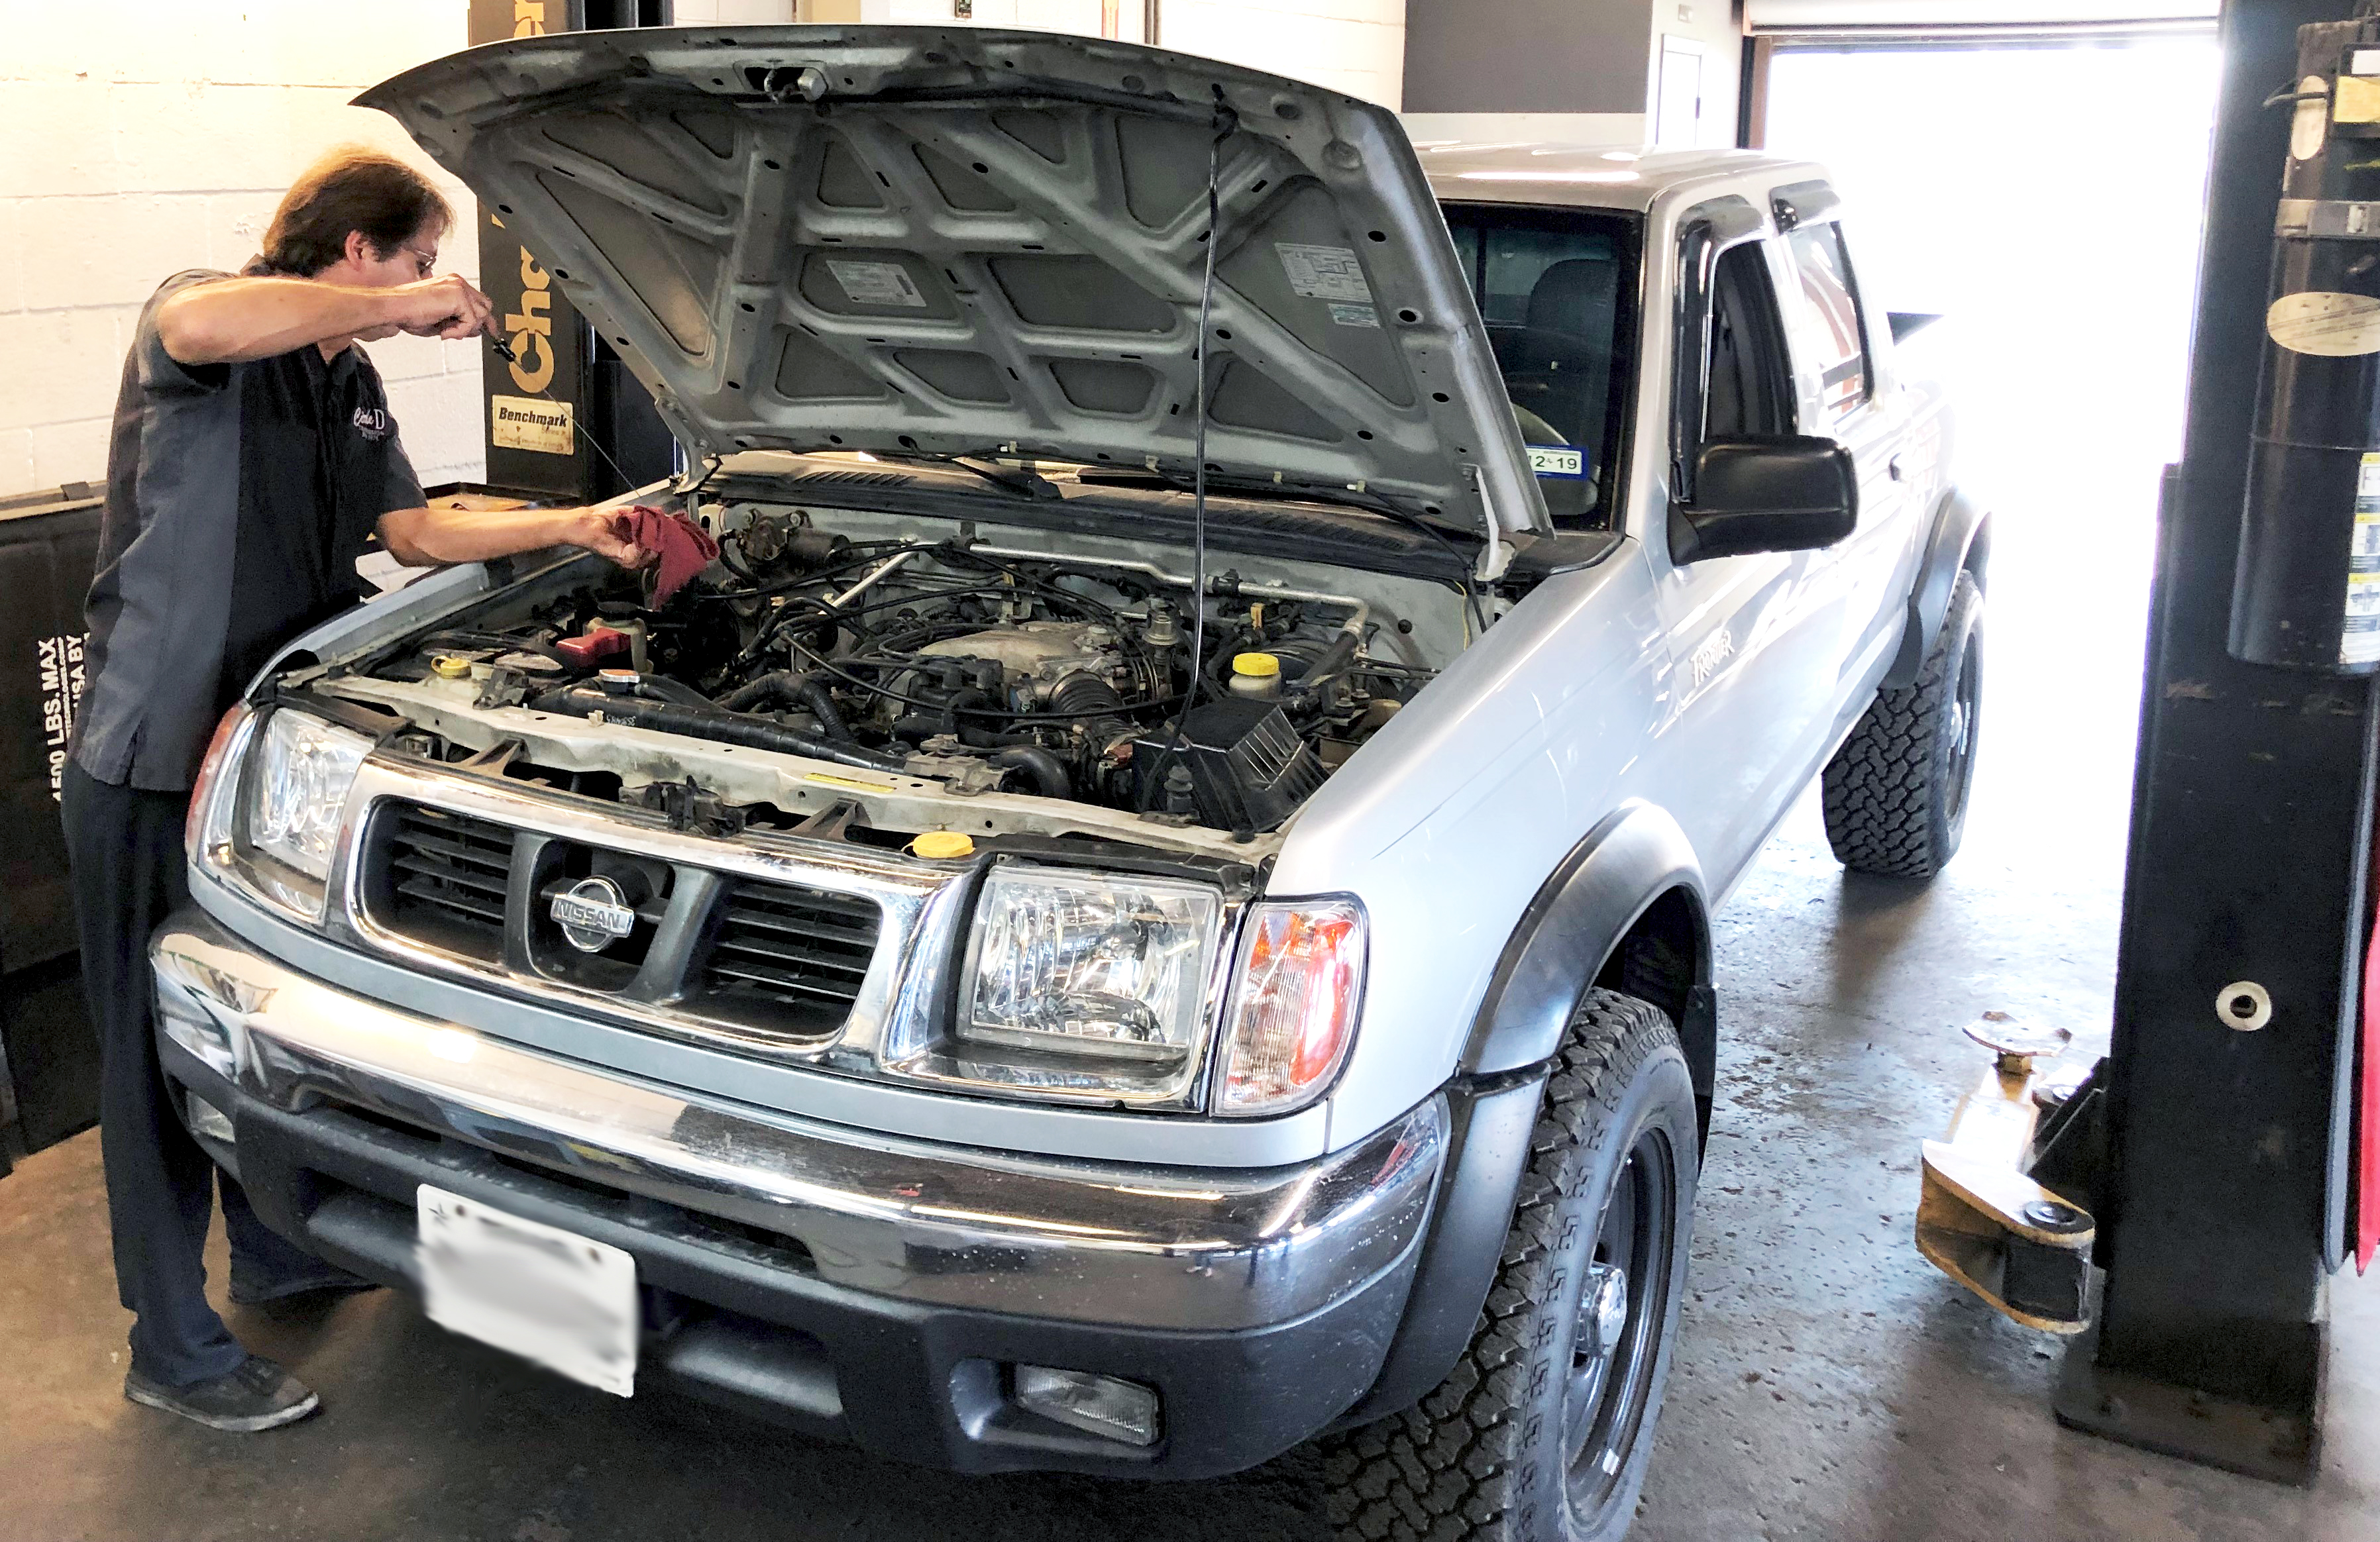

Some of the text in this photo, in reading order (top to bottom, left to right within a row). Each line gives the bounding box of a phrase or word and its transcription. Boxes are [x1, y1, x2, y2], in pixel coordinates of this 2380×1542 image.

[499, 407, 567, 428] Benchmark
[38, 638, 60, 691] MAX
[66, 635, 84, 663] BY
[44, 692, 65, 746] LBS.
[555, 899, 621, 930] NISSAN
